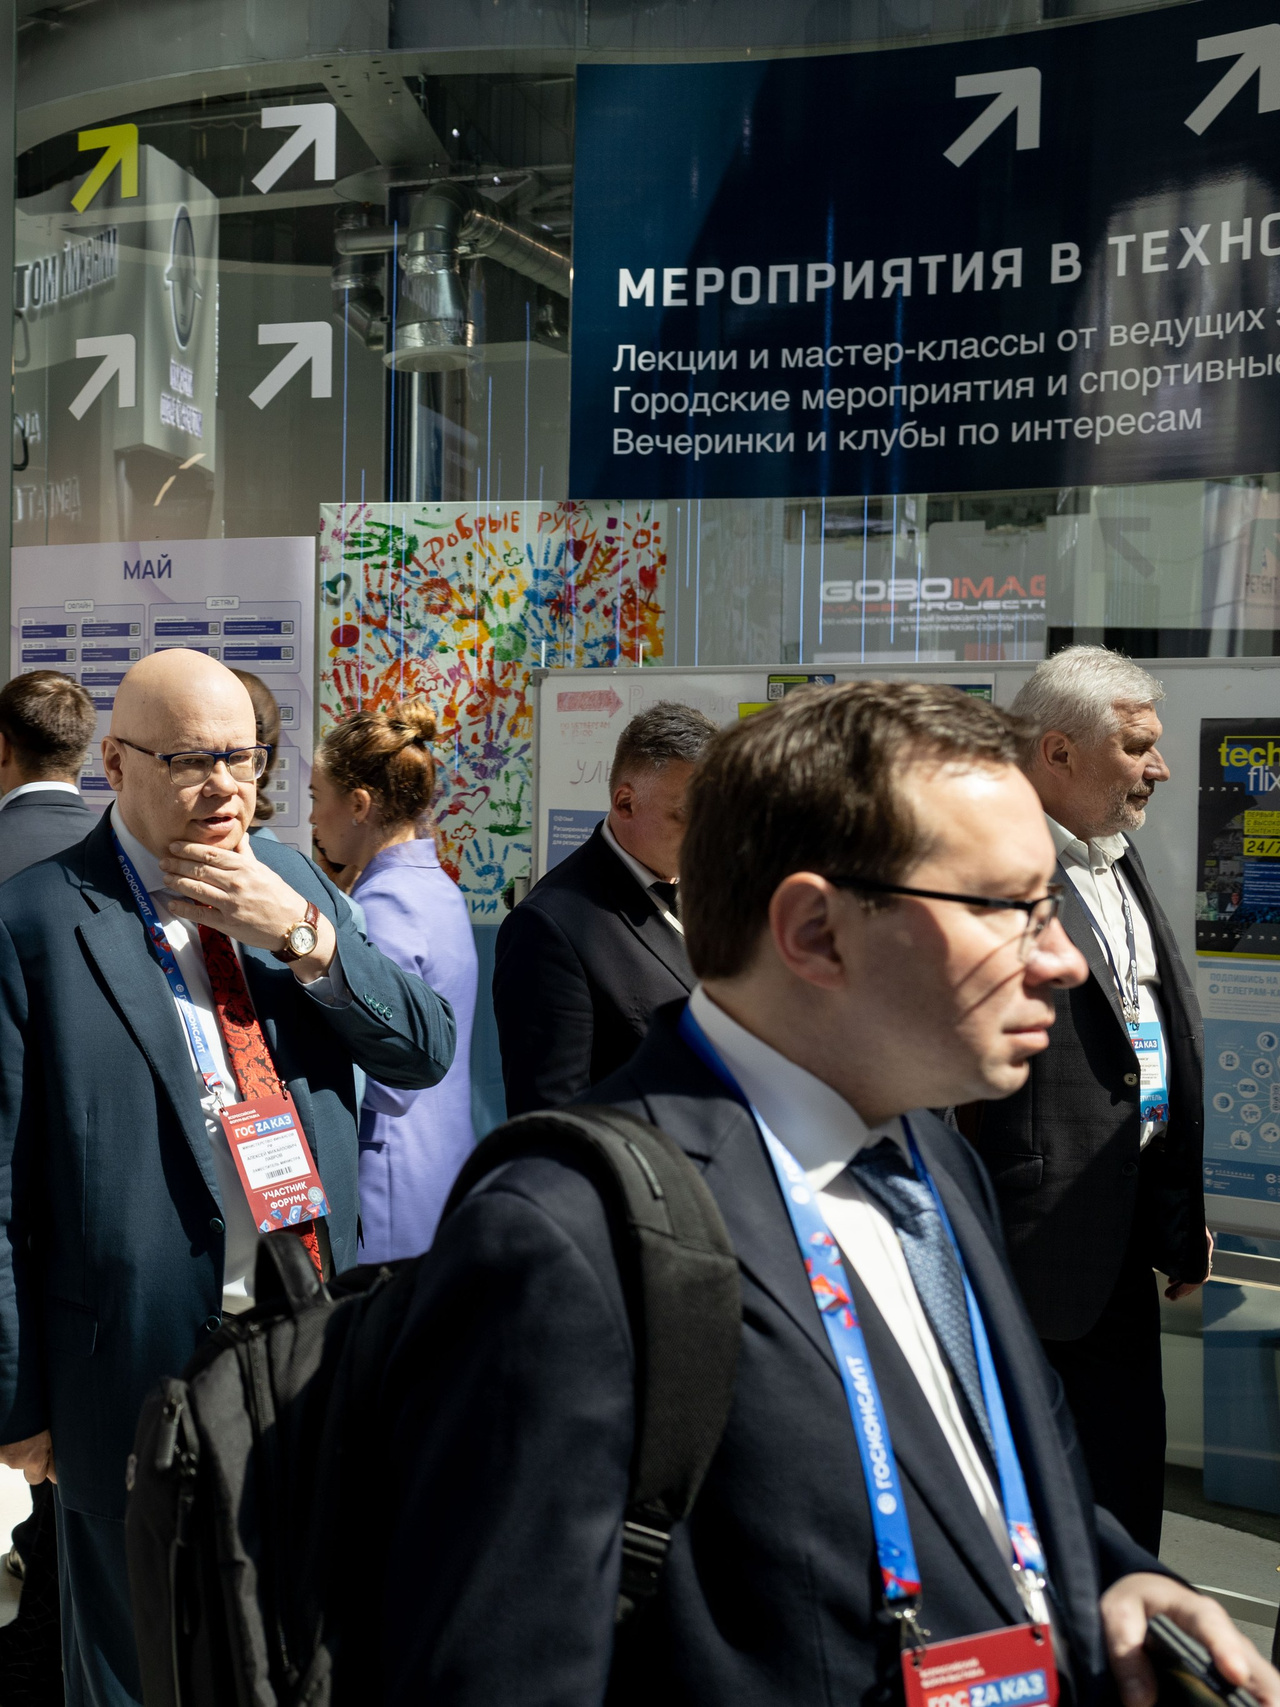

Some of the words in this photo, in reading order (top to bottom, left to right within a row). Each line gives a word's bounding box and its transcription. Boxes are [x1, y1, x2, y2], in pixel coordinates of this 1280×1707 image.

[617, 247, 1023, 307] МЕРОПРИЯТИЯ
[1050, 242, 1082, 284] В
[1108, 211, 1280, 278] ТЕХНО
[613, 344, 738, 374] Лекции
[749, 348, 770, 370] и
[780, 332, 1046, 371] мастер-классы
[1056, 326, 1097, 353] от
[1108, 307, 1265, 348] ведущих
[613, 386, 790, 419] Городские
[801, 372, 1035, 412] мероприятия
[1047, 372, 1068, 396] и
[1079, 353, 1280, 402] спортивны
[613, 427, 795, 461] Вечеринки
[806, 430, 827, 453] и
[838, 420, 946, 457] клубы
[958, 420, 1000, 447] по
[1010, 405, 1203, 446] интересам
[123, 553, 172, 580] МАЙ
[908, 599, 1046, 612] PROJECT
[1247, 765, 1280, 792] flix
[122, 861, 153, 917] ГОСКОНСАЛТ
[1210, 973, 1265, 984] ПОДПИШИСЬ
[1266, 976, 1278, 985] НА
[262, 1181, 308, 1201] УЧАСТНИК
[270, 1193, 308, 1210] ФОРУМА
[846, 1356, 892, 1488] ГОСКОНСАЛТ
